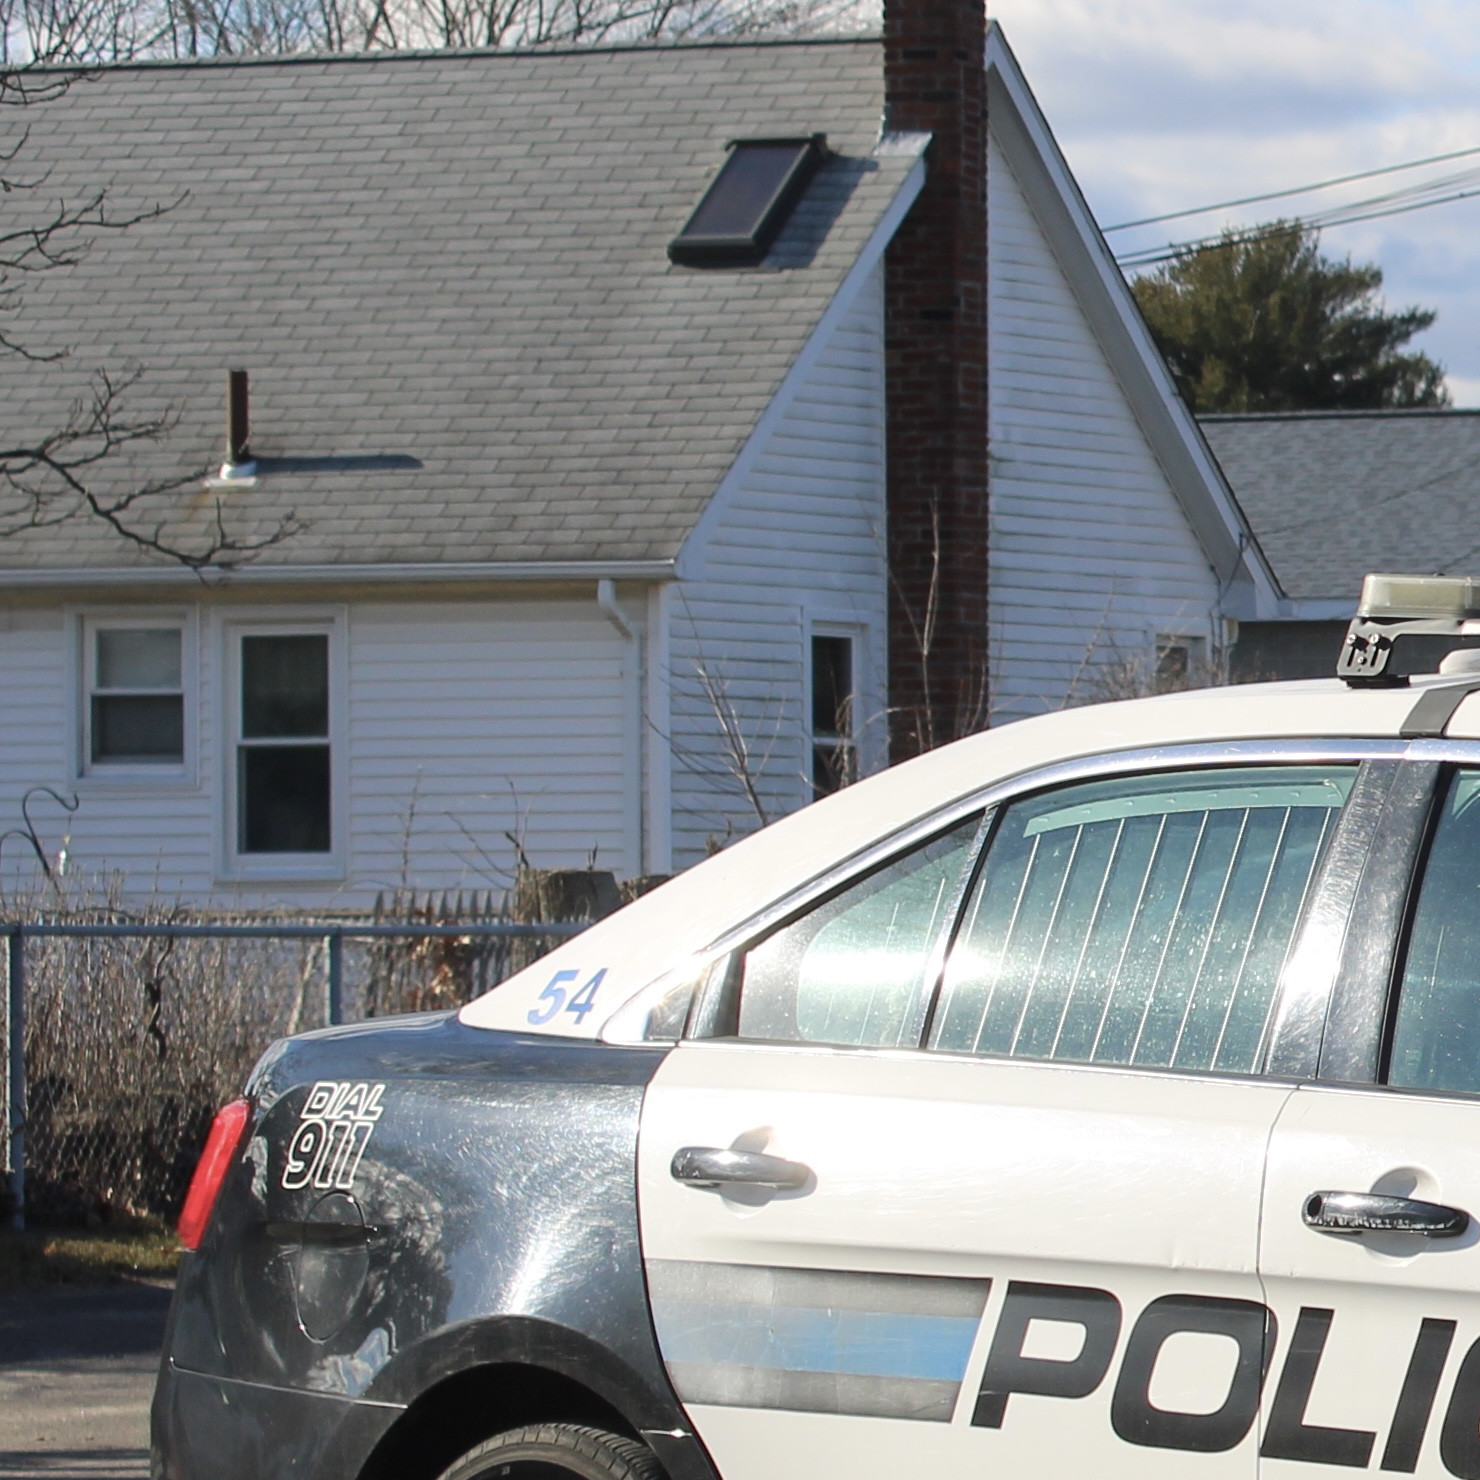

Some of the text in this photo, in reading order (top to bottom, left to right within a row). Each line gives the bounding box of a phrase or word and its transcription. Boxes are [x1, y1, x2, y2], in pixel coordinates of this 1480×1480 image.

[527, 967, 609, 1025] 54
[300, 1082, 386, 1120] DIAL
[281, 1118, 374, 1189] 911
